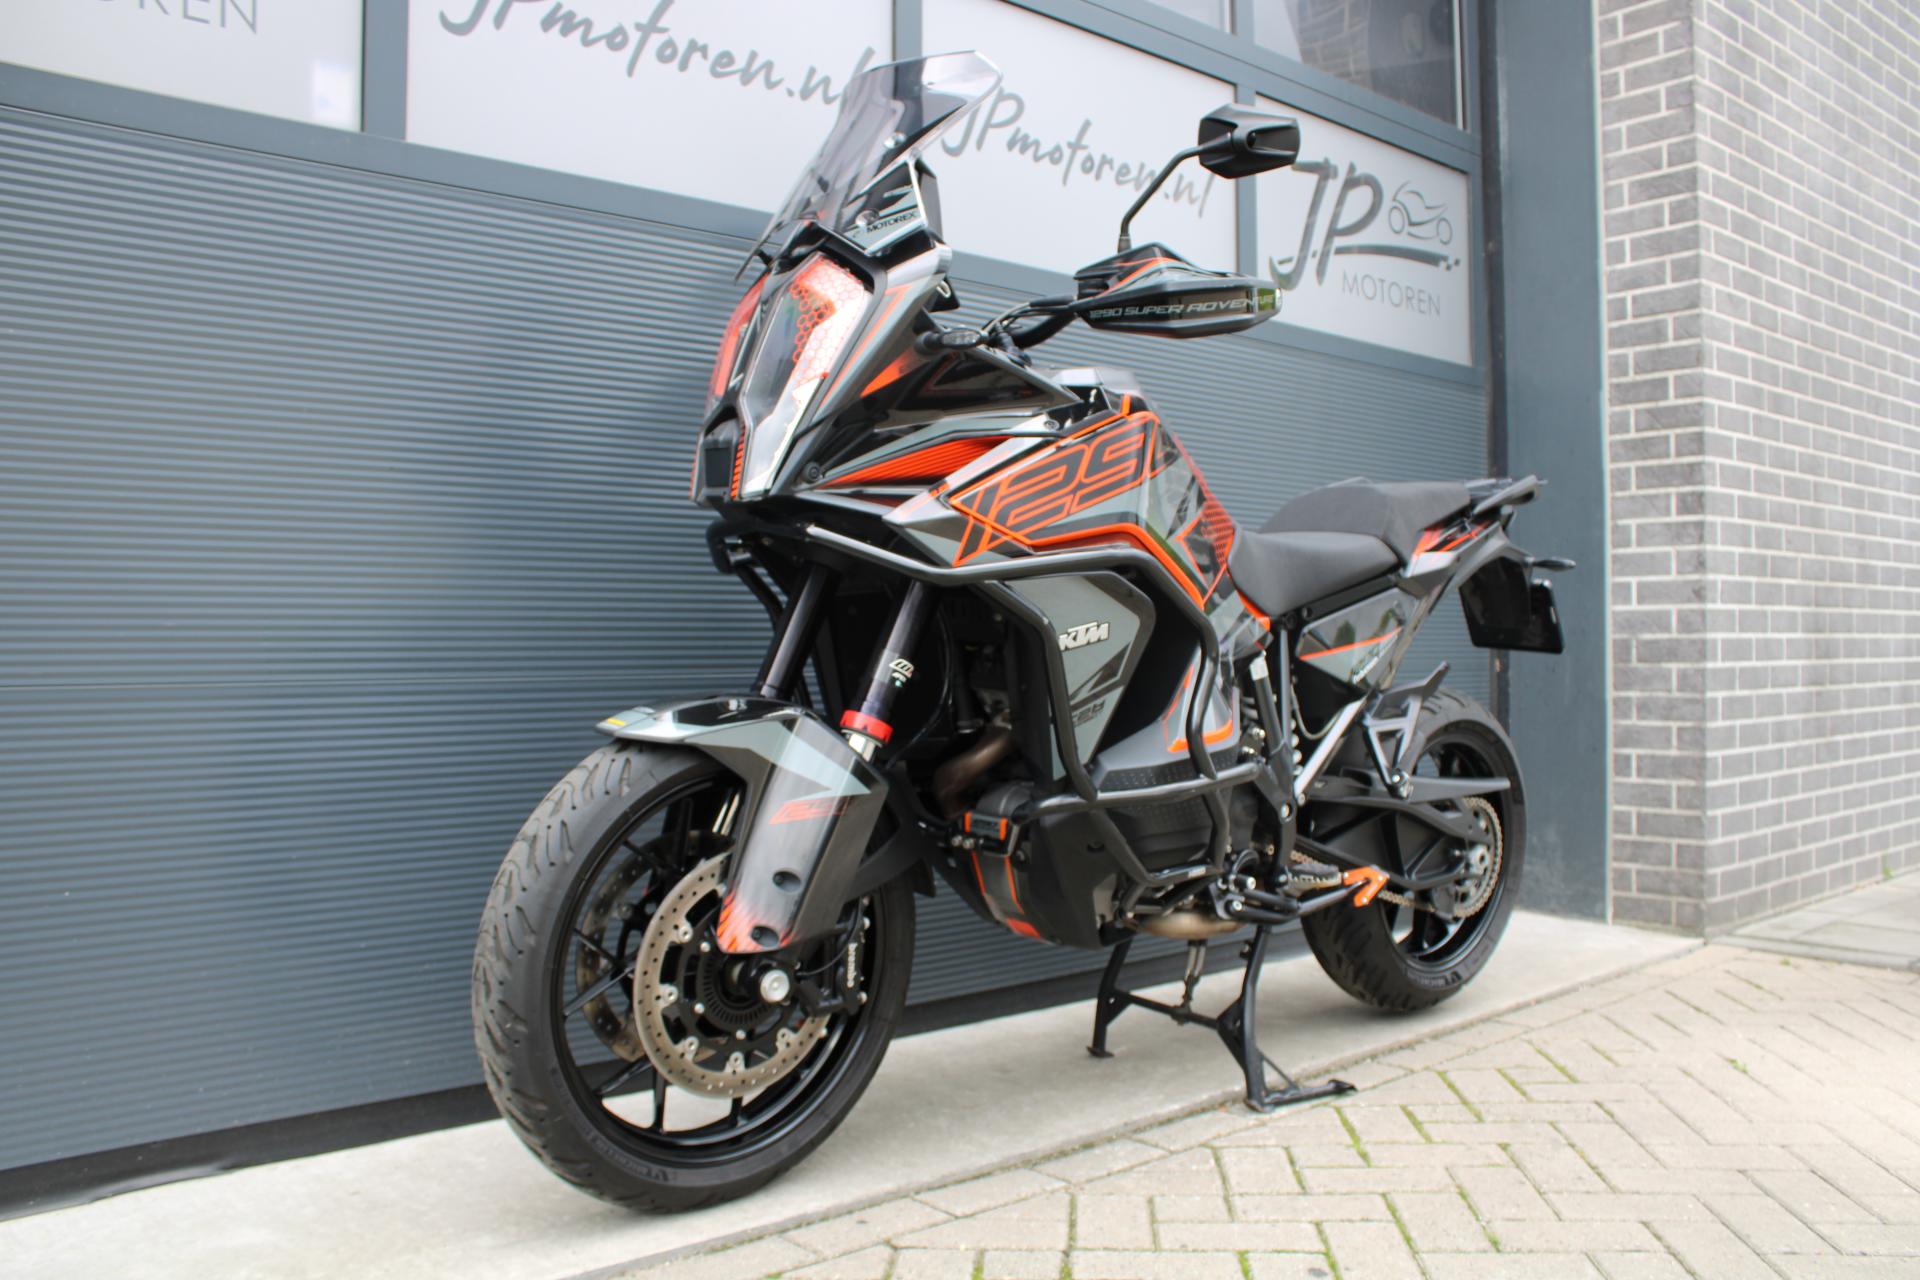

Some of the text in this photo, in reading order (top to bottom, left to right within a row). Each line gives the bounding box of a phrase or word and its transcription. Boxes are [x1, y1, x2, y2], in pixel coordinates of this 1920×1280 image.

[941, 86, 1214, 218] JPmotoren.nl
[866, 211, 917, 233] MOTOREX
[1089, 307, 1123, 320] 1290
[1124, 304, 1183, 316] SUPER
[1342, 269, 1441, 317] MOTOREN
[1058, 621, 1109, 652] KTM
[847, 942, 858, 988] brembo
